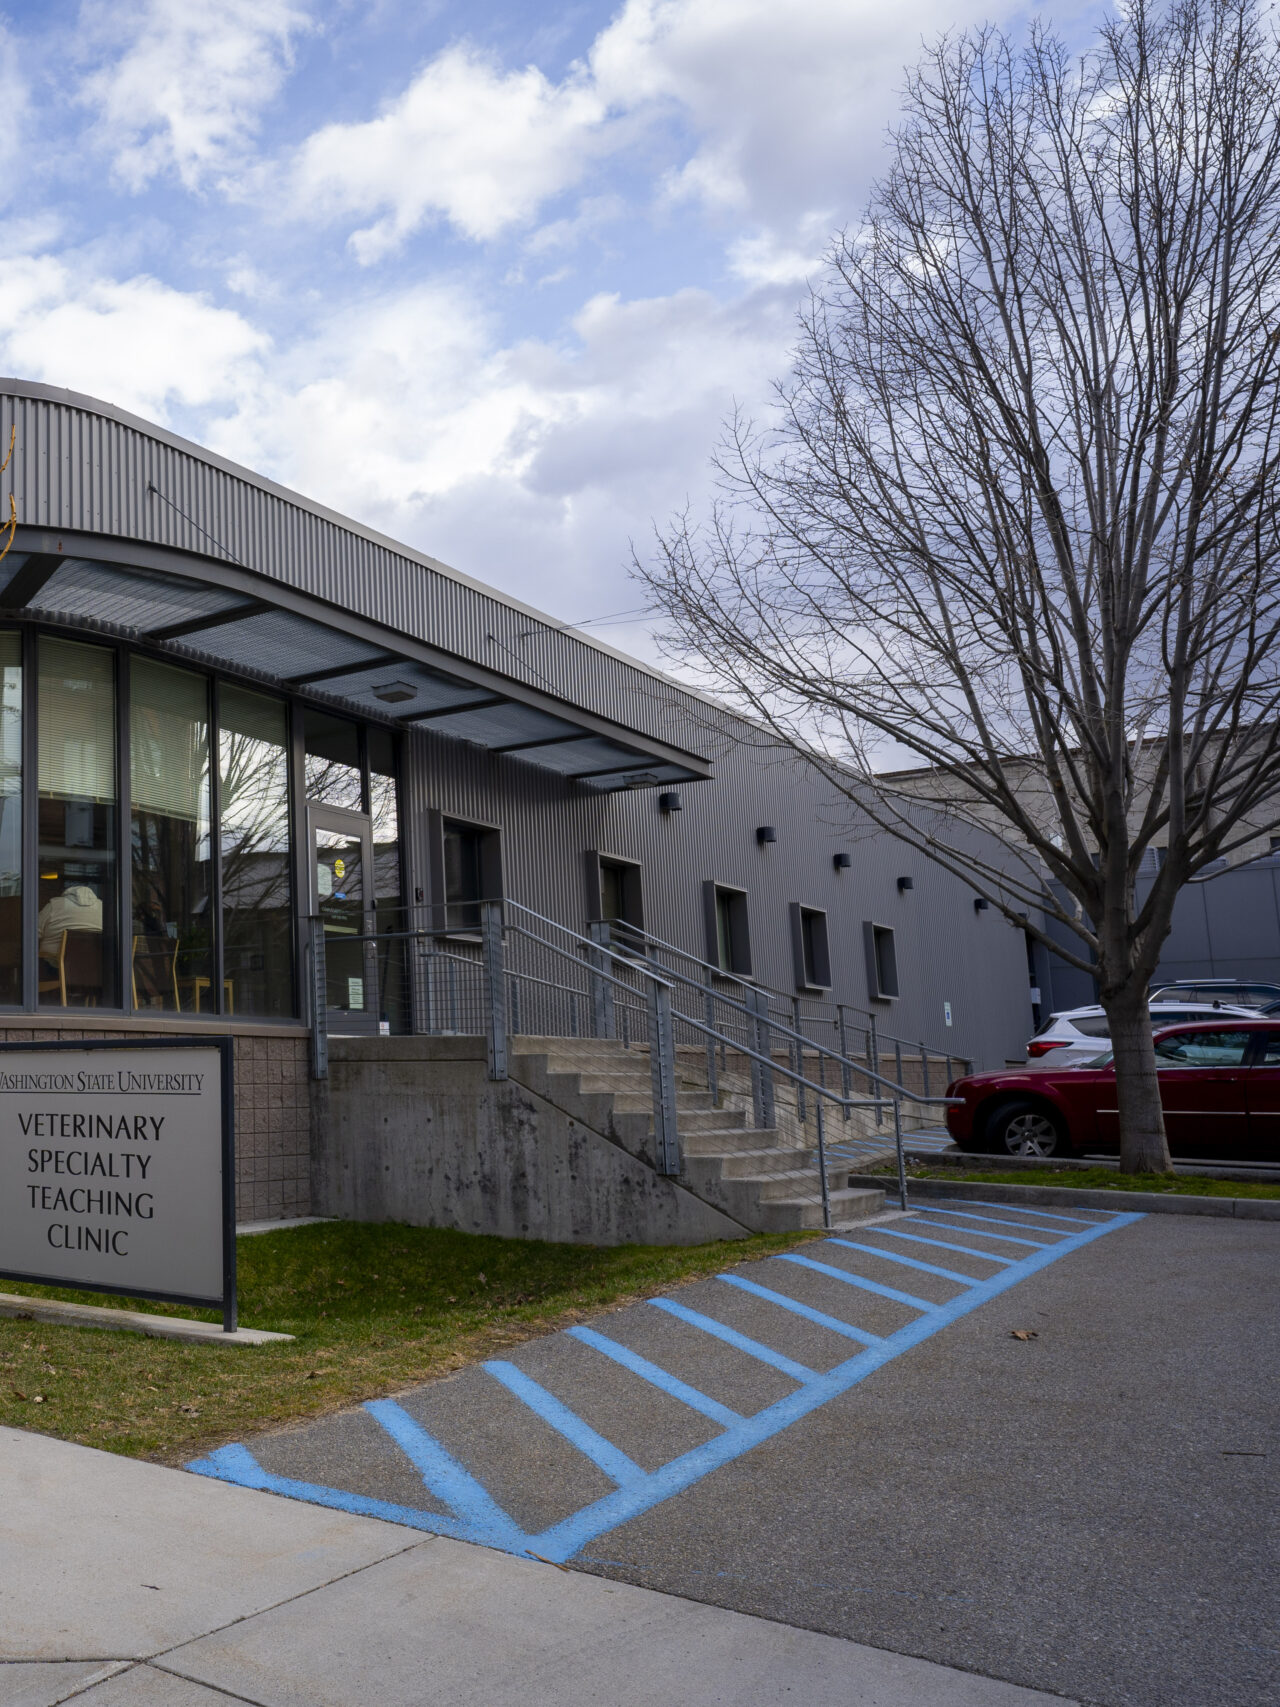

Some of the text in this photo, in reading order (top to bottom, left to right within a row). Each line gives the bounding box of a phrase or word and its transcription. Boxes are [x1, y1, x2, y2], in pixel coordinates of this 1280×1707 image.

[76, 1070, 116, 1092] STATE
[117, 1071, 204, 1092] UNIVERSITY
[18, 1112, 165, 1141] VETERINARY
[27, 1148, 152, 1179] SPECIALTY
[26, 1184, 154, 1219] TEACHING
[47, 1223, 129, 1256] CLINIC
